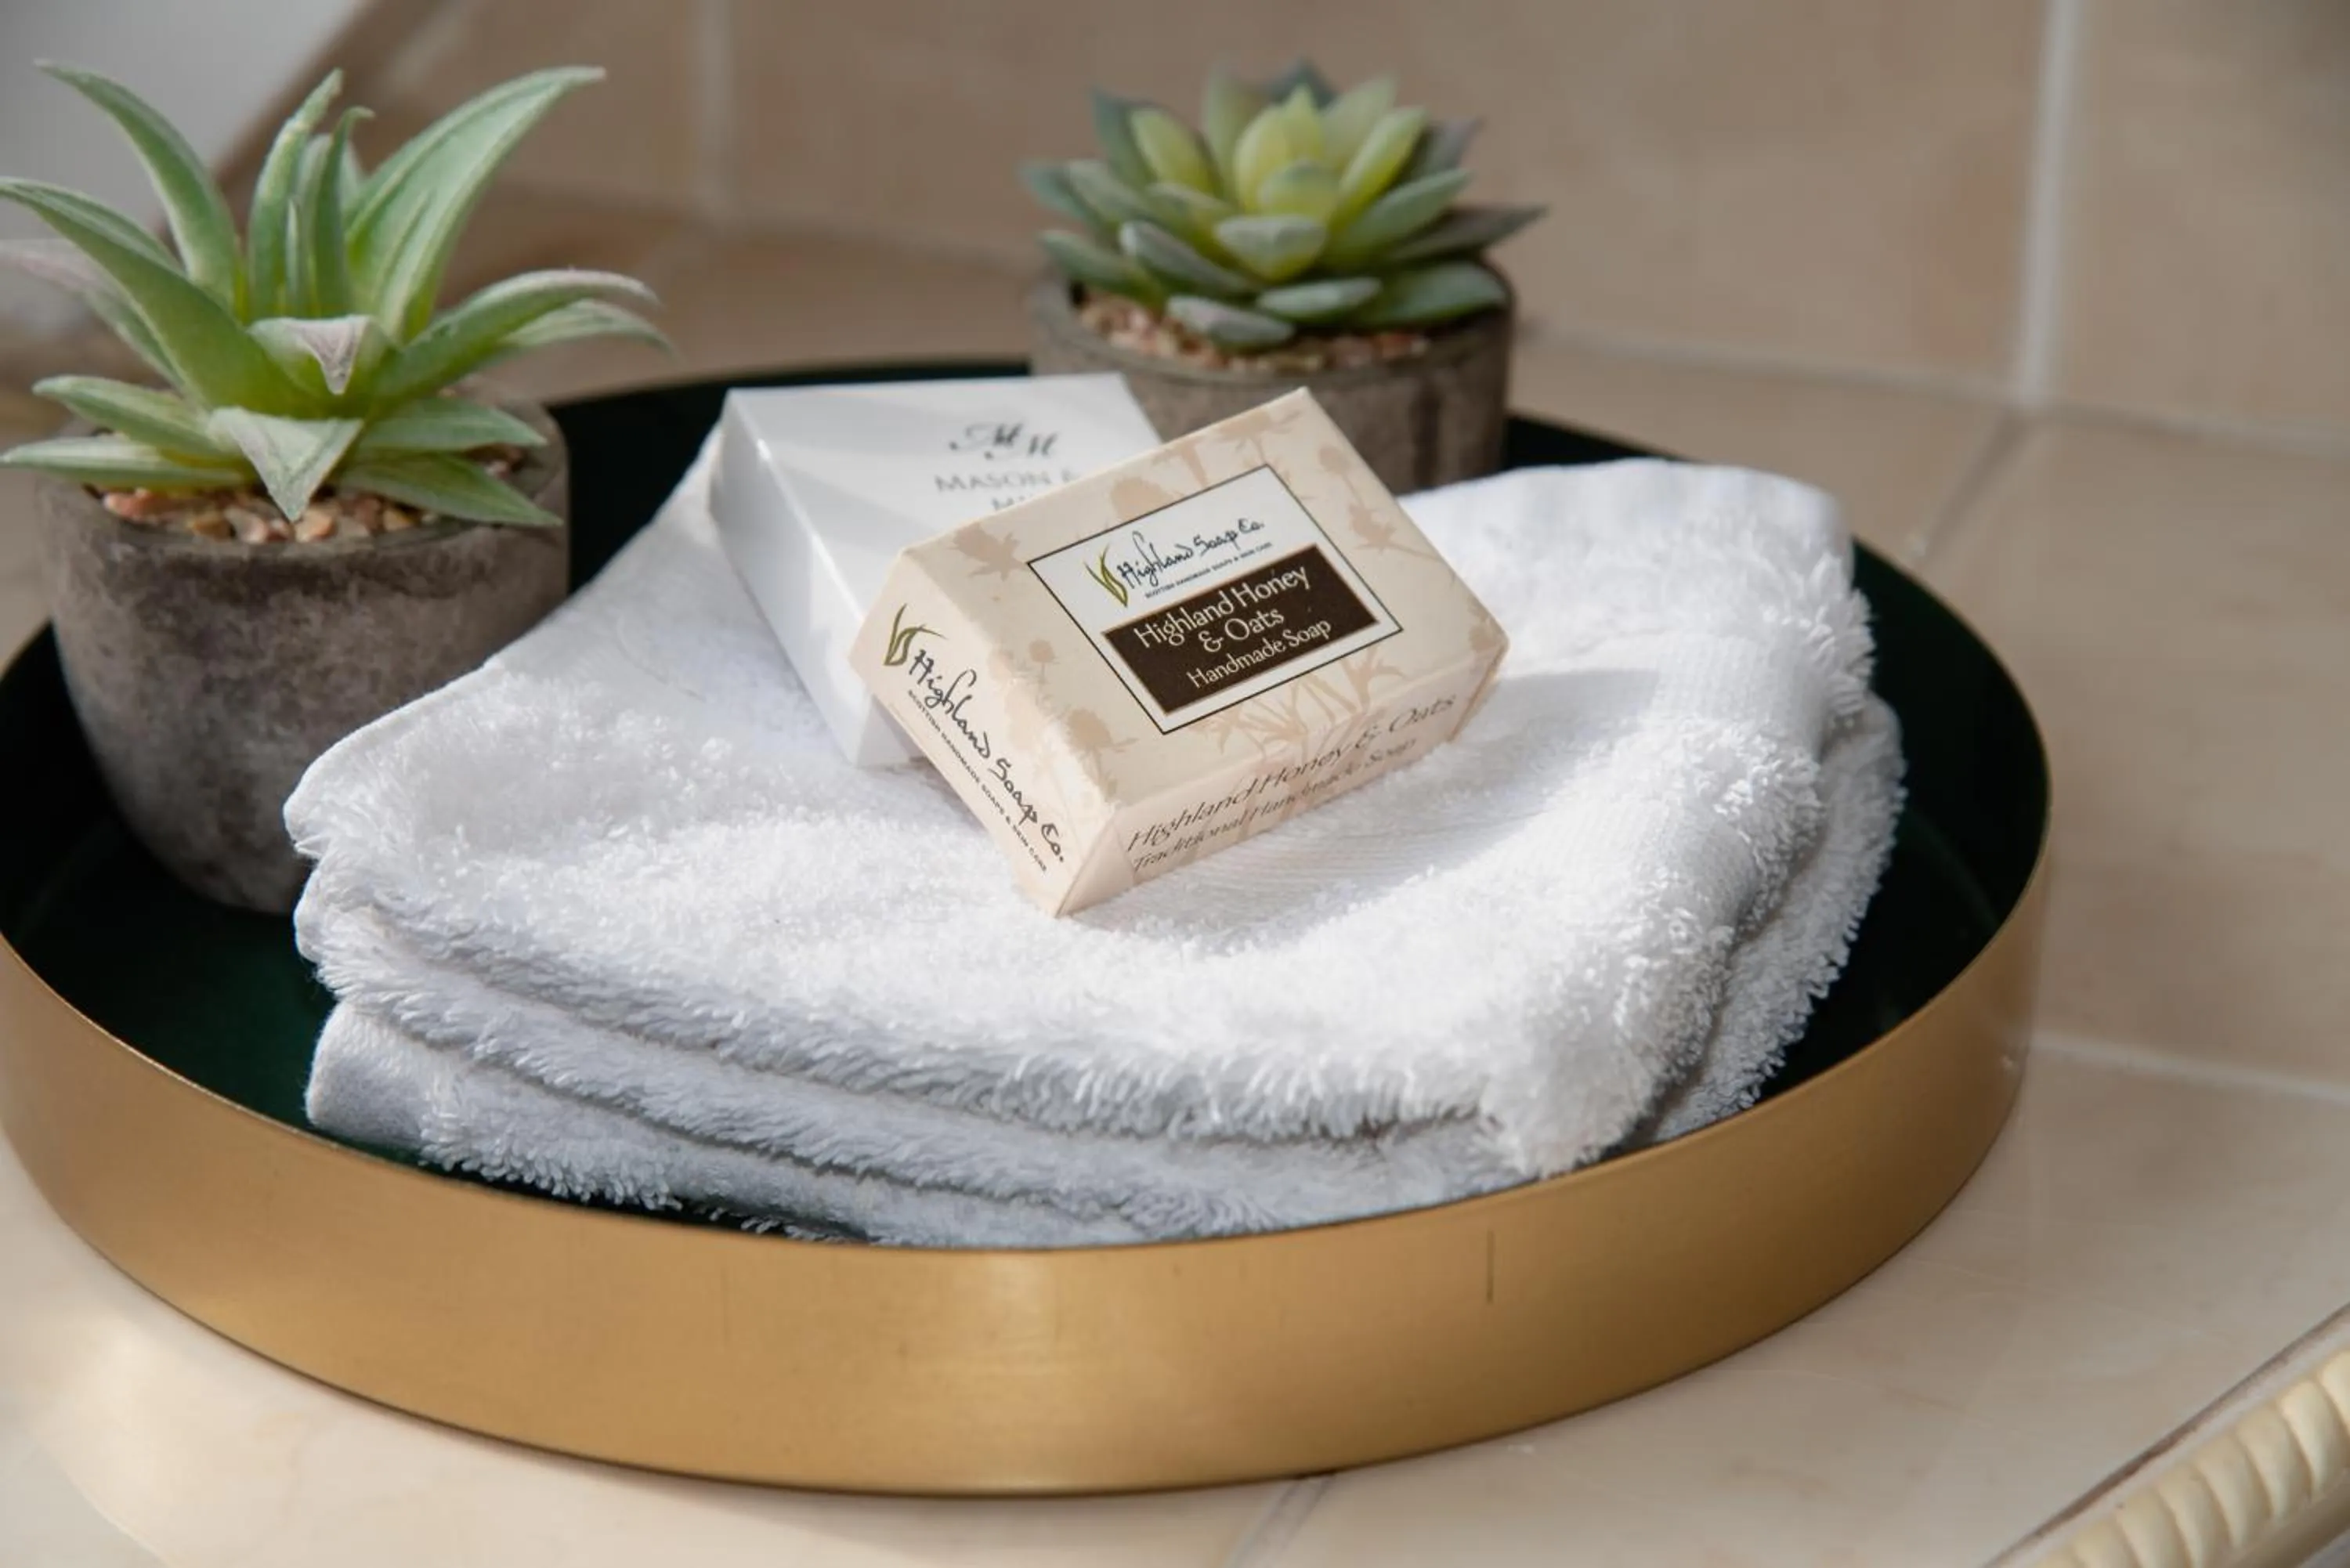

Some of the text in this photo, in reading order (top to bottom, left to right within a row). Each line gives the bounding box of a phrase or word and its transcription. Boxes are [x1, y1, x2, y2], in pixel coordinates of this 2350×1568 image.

[1116, 530, 1195, 589] Highland
[1193, 531, 1241, 556] Soap
[1133, 566, 1311, 649] Highland Honey
[1198, 607, 1285, 653] & Oats
[1187, 619, 1331, 689] Handmade Soap
[909, 649, 991, 759] Highland
[988, 757, 1038, 826] Soap
[1128, 778, 1260, 851] Highland
[1256, 746, 1352, 795] Honey
[1387, 694, 1456, 732] Oats
